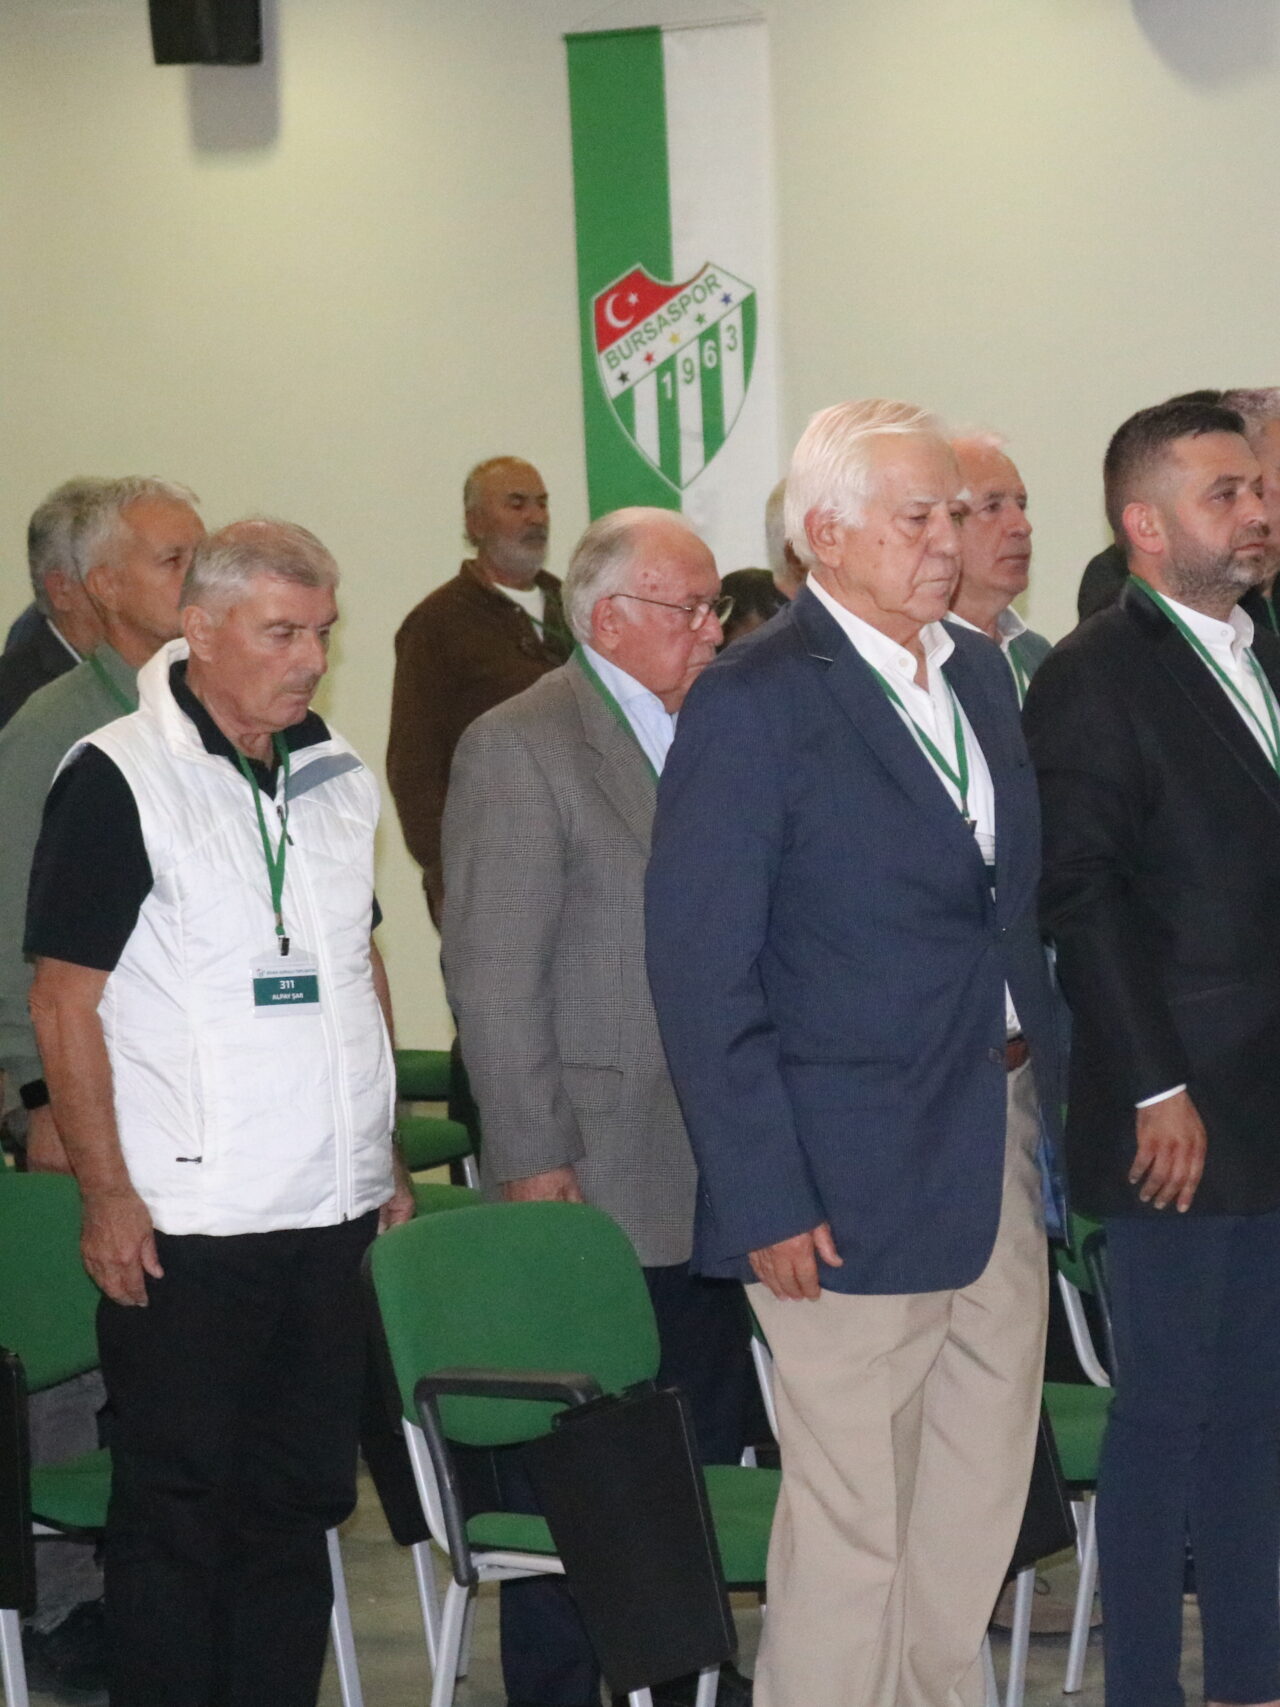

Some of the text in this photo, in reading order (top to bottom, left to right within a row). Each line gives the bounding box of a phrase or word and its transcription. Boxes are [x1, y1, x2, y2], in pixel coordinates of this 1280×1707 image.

[605, 273, 722, 370] BURSASPOR
[661, 324, 738, 400] 1963
[279, 980, 295, 990] 311
